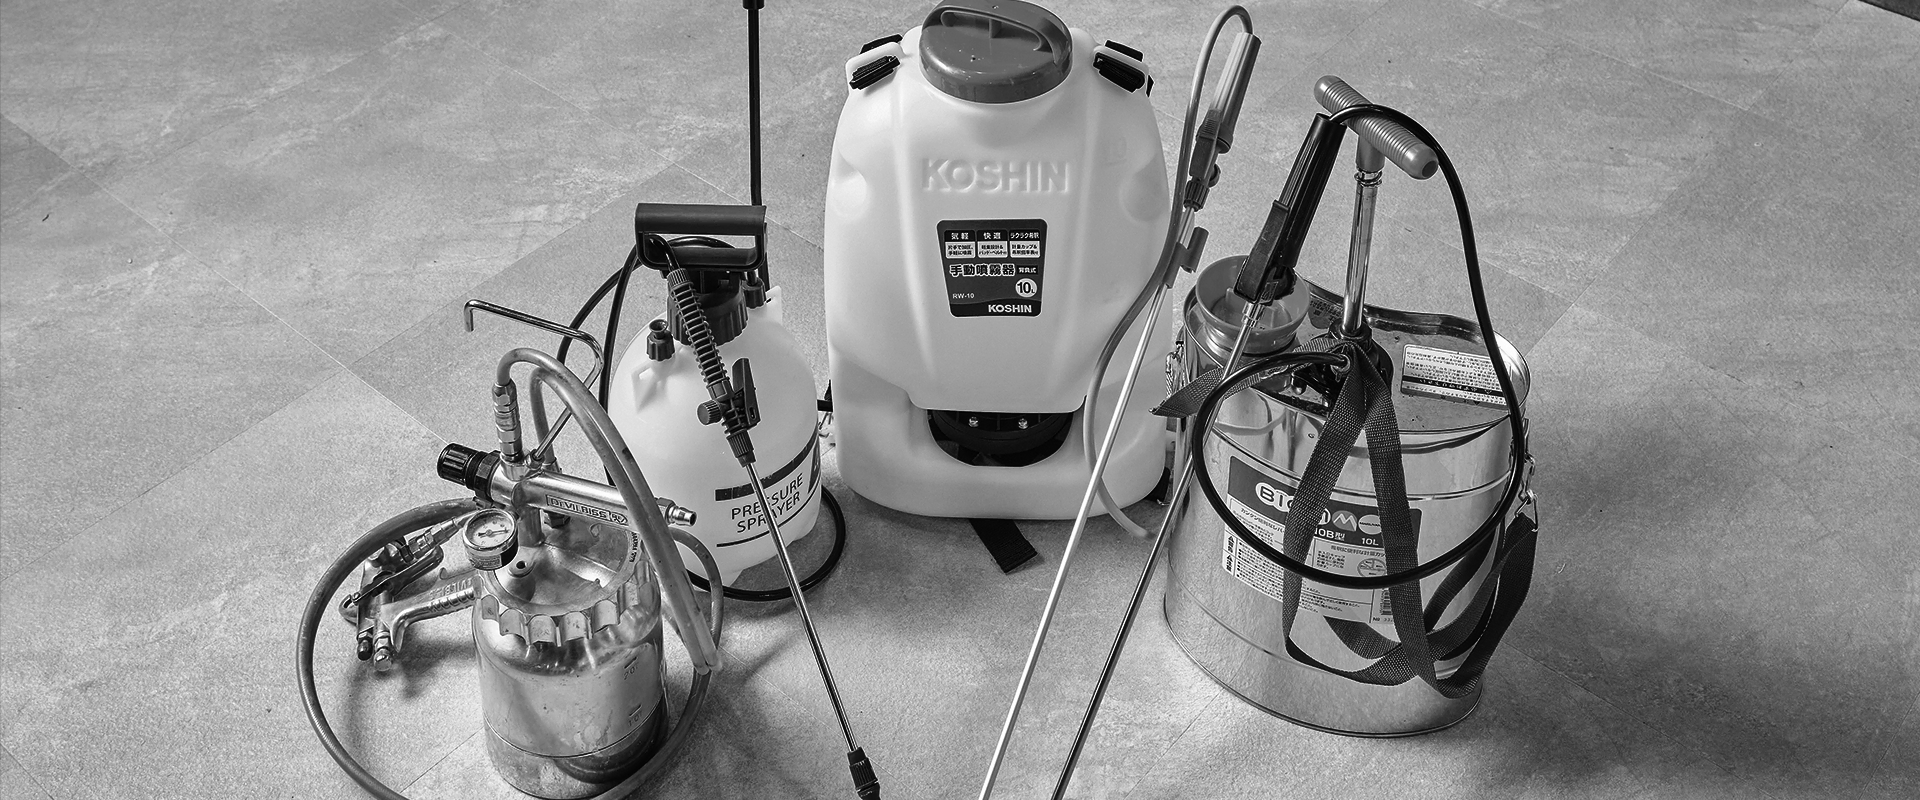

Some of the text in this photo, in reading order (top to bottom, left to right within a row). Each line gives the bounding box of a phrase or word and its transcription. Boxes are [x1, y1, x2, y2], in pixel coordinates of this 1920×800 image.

[921, 158, 1070, 193] KOSHIN
[949, 263, 1016, 277] 手動噴霧器
[988, 304, 1032, 313] KOSHIN
[731, 472, 804, 520] PRESURE
[1361, 537, 1379, 546] 10L
